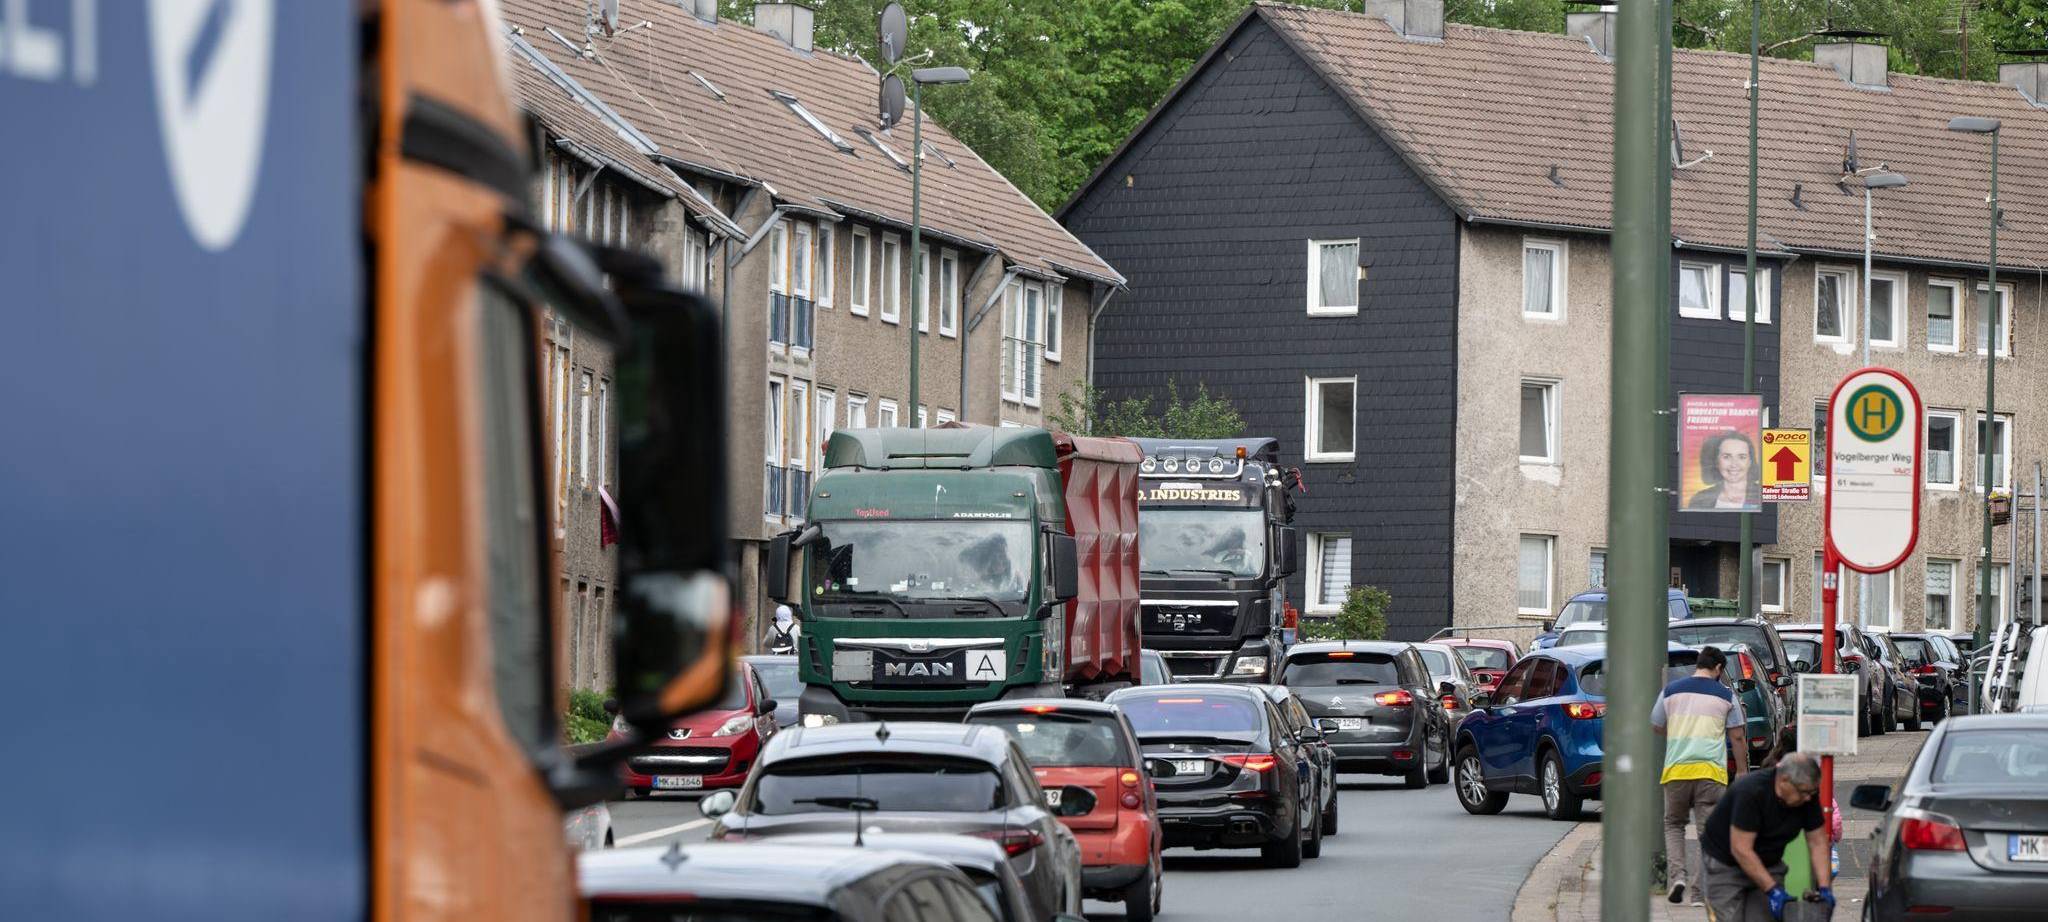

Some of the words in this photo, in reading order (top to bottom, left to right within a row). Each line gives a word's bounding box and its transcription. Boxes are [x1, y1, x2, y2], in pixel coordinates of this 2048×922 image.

[1687, 408, 1728, 416] INNOVATION
[1729, 408, 1759, 416] BRAUCHT
[1863, 398, 1886, 429] H
[1687, 416, 1719, 424] FREIHEIT
[1836, 452, 1889, 463] Vogelberger
[1892, 453, 1912, 464] Weg
[1150, 489, 1240, 501] INDUSTRIES
[855, 508, 889, 518] TopUsed
[1157, 613, 1202, 624] MAN
[885, 662, 954, 676] MAN
[974, 654, 997, 676] A
[2020, 838, 2040, 855] MK
